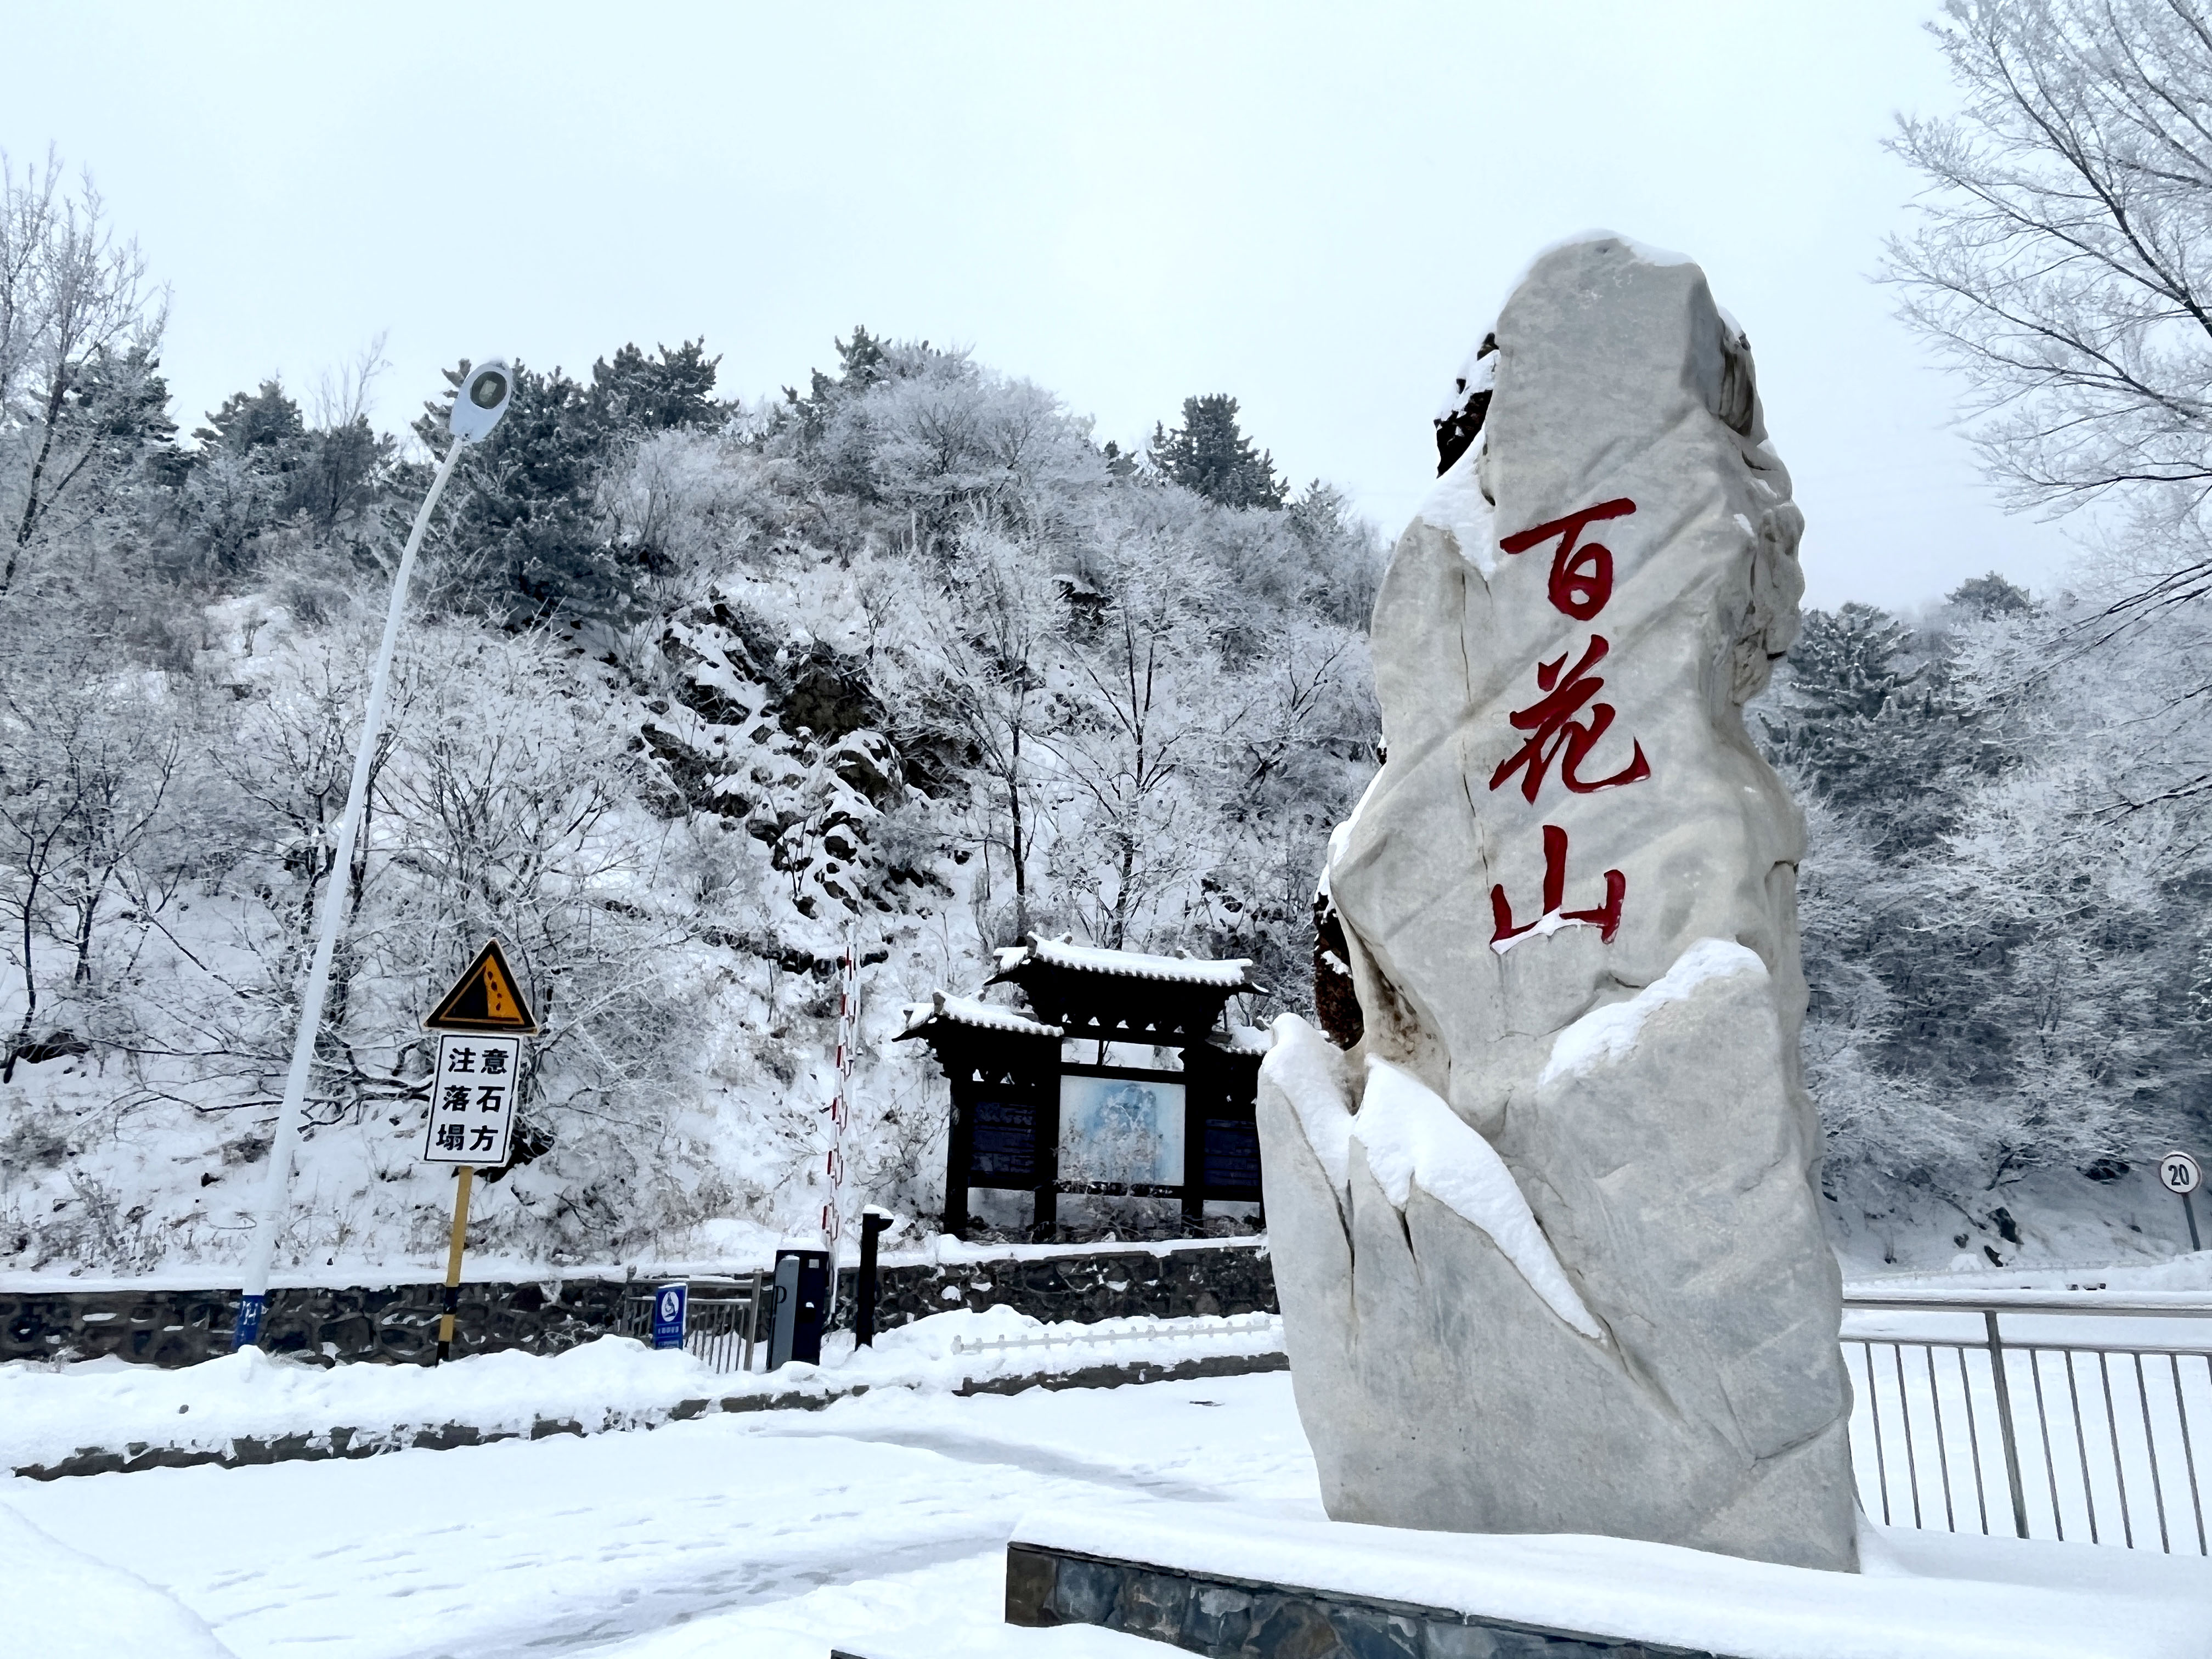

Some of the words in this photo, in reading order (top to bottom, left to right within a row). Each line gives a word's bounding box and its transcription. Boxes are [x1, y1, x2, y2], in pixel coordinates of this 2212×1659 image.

[1491, 498, 1651, 956] 百花山
[448, 1047, 509, 1074] 注意
[442, 1085, 506, 1113] 落石
[436, 1124, 499, 1152] 塌方
[2168, 1164, 2190, 1186] 20
